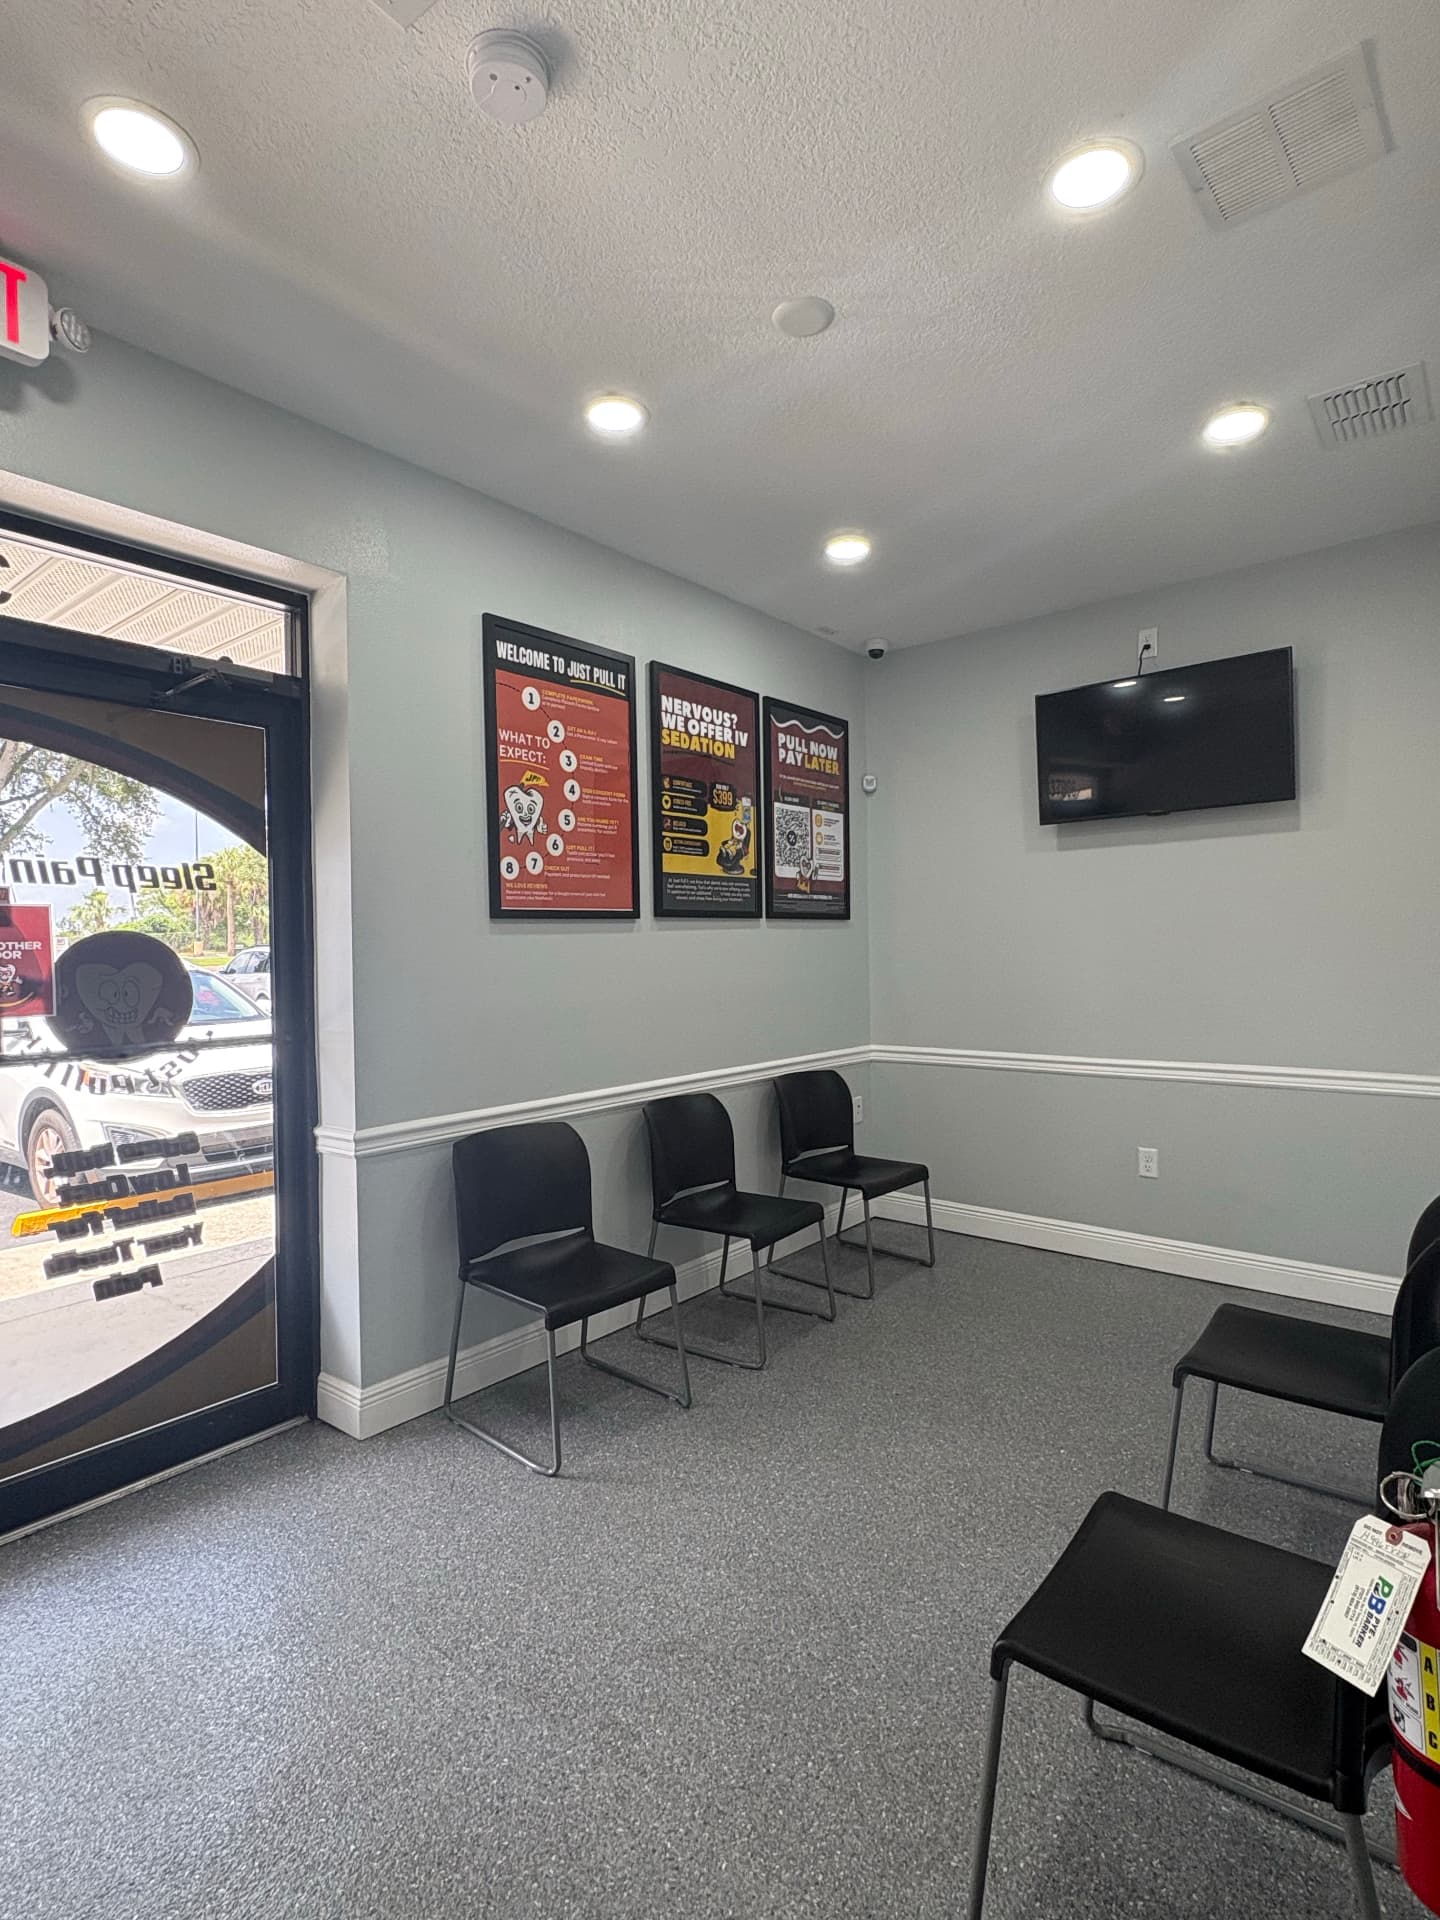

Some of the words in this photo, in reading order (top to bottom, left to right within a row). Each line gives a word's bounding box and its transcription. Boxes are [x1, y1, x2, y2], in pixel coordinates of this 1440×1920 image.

[496, 640, 550, 671] WELCOME
[552, 656, 564, 674] TO
[568, 661, 591, 681] JUST
[593, 667, 616, 688] PULL
[618, 674, 626, 690] IT
[528, 692, 535, 705] 1
[661, 695, 738, 729] NERVOUS?
[499, 728, 532, 746] WHAT
[535, 735, 550, 749] TO
[553, 726, 560, 737] 2
[661, 712, 685, 732] WE
[687, 719, 733, 743] OFFER
[735, 730, 748, 747] IV
[662, 728, 736, 759] SEDATION
[778, 732, 808, 753] PULL
[810, 741, 838, 760] NOW
[500, 745, 546, 764] EXPECT:
[566, 756, 572, 767] 3
[778, 748, 803, 766] PAY
[804, 755, 840, 775] LATER
[569, 785, 576, 796] 4
[713, 789, 733, 806] $399
[564, 815, 571, 826] 5
[552, 840, 559, 851] 6
[505, 862, 514, 874] 8
[531, 858, 538, 870] 7
[0, 941, 42, 950] OTHER
[0, 950, 22, 959] OR
[1354, 1611, 1374, 1648] BARKER
[1424, 1656, 1434, 1675] A
[1426, 1692, 1436, 1711] B
[1428, 1730, 1438, 1750] C
